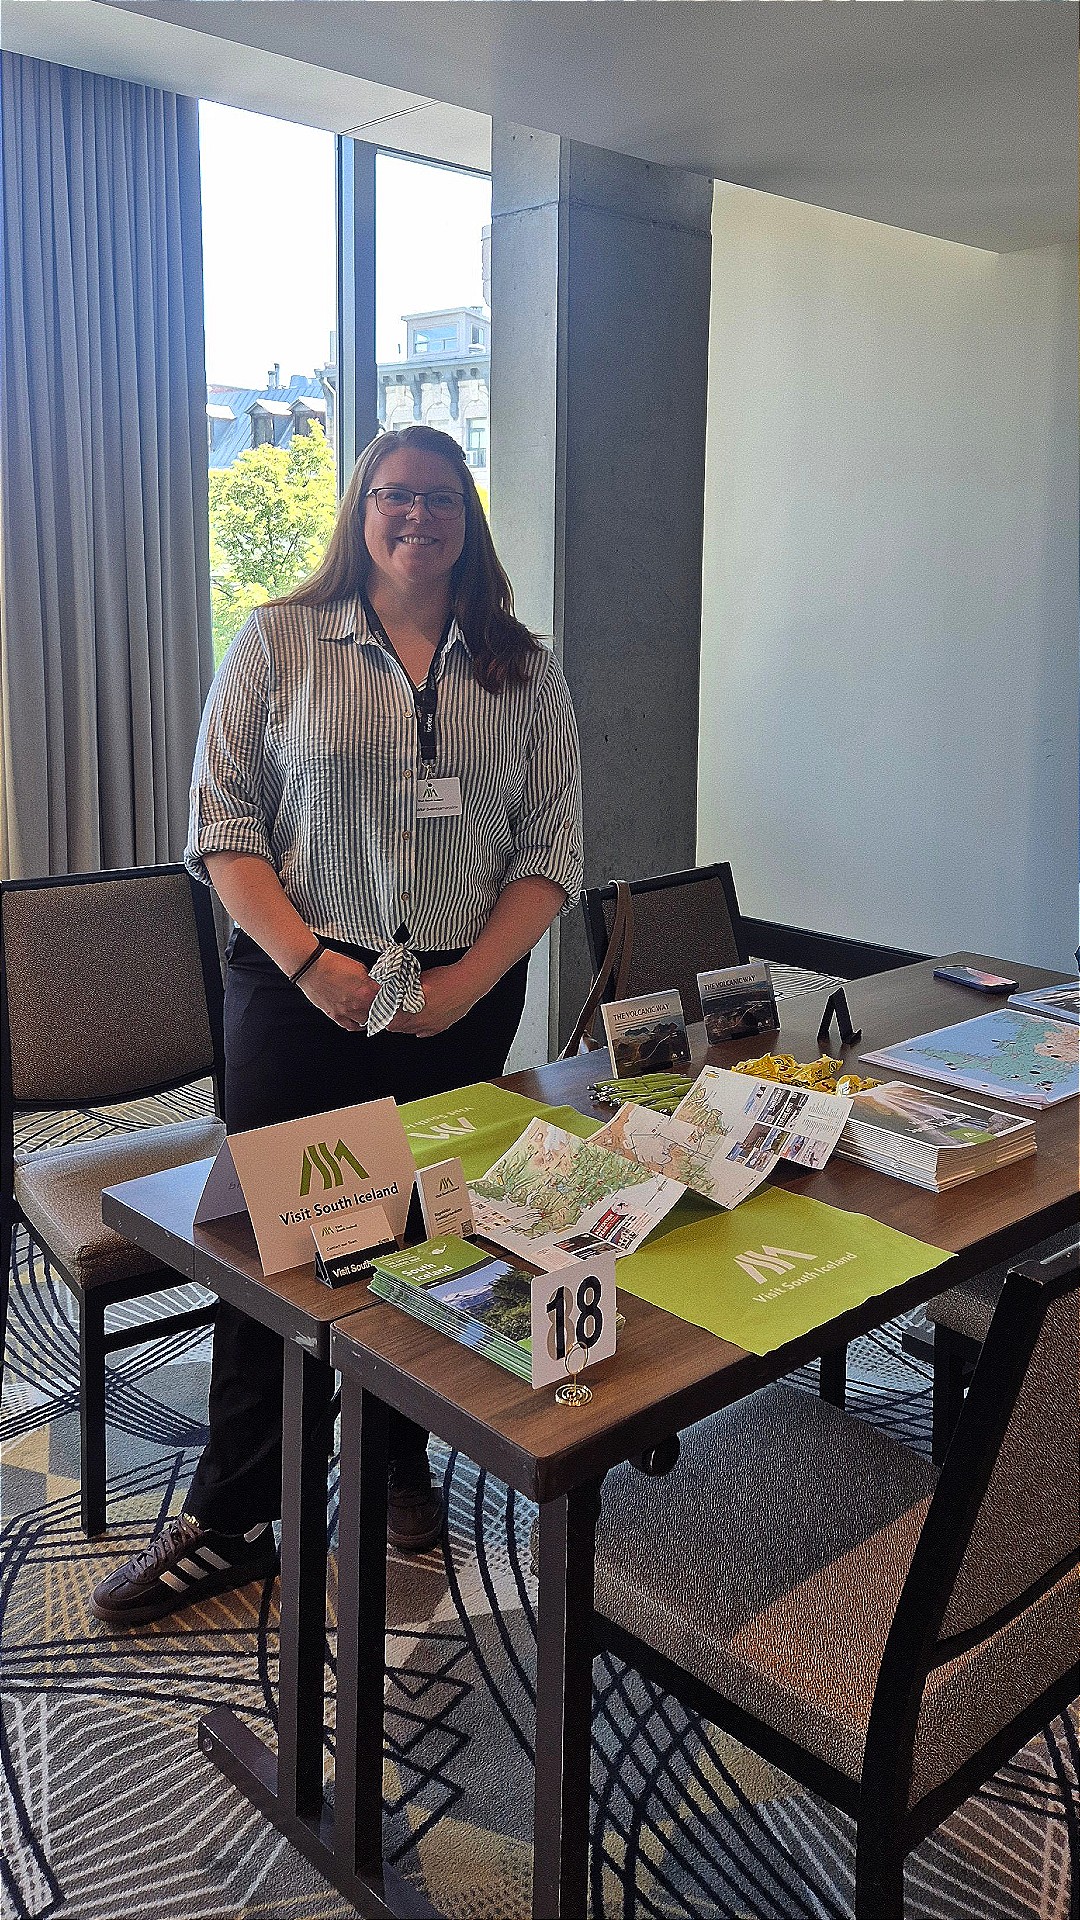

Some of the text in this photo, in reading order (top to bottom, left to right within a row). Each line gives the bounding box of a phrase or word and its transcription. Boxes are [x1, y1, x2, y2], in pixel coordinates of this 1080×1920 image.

[704, 974, 756, 991] THE VOLCANIC WAY
[613, 1002, 670, 1021] THE VOLCANIC WAY
[279, 1181, 399, 1227] Visit South Iceland
[332, 1265, 351, 1279] Visit
[350, 1260, 374, 1273] South
[402, 1262, 438, 1277] South
[411, 1264, 454, 1282] Iceland
[752, 1252, 858, 1304] Visit South Iceland
[546, 1275, 604, 1361] 18
